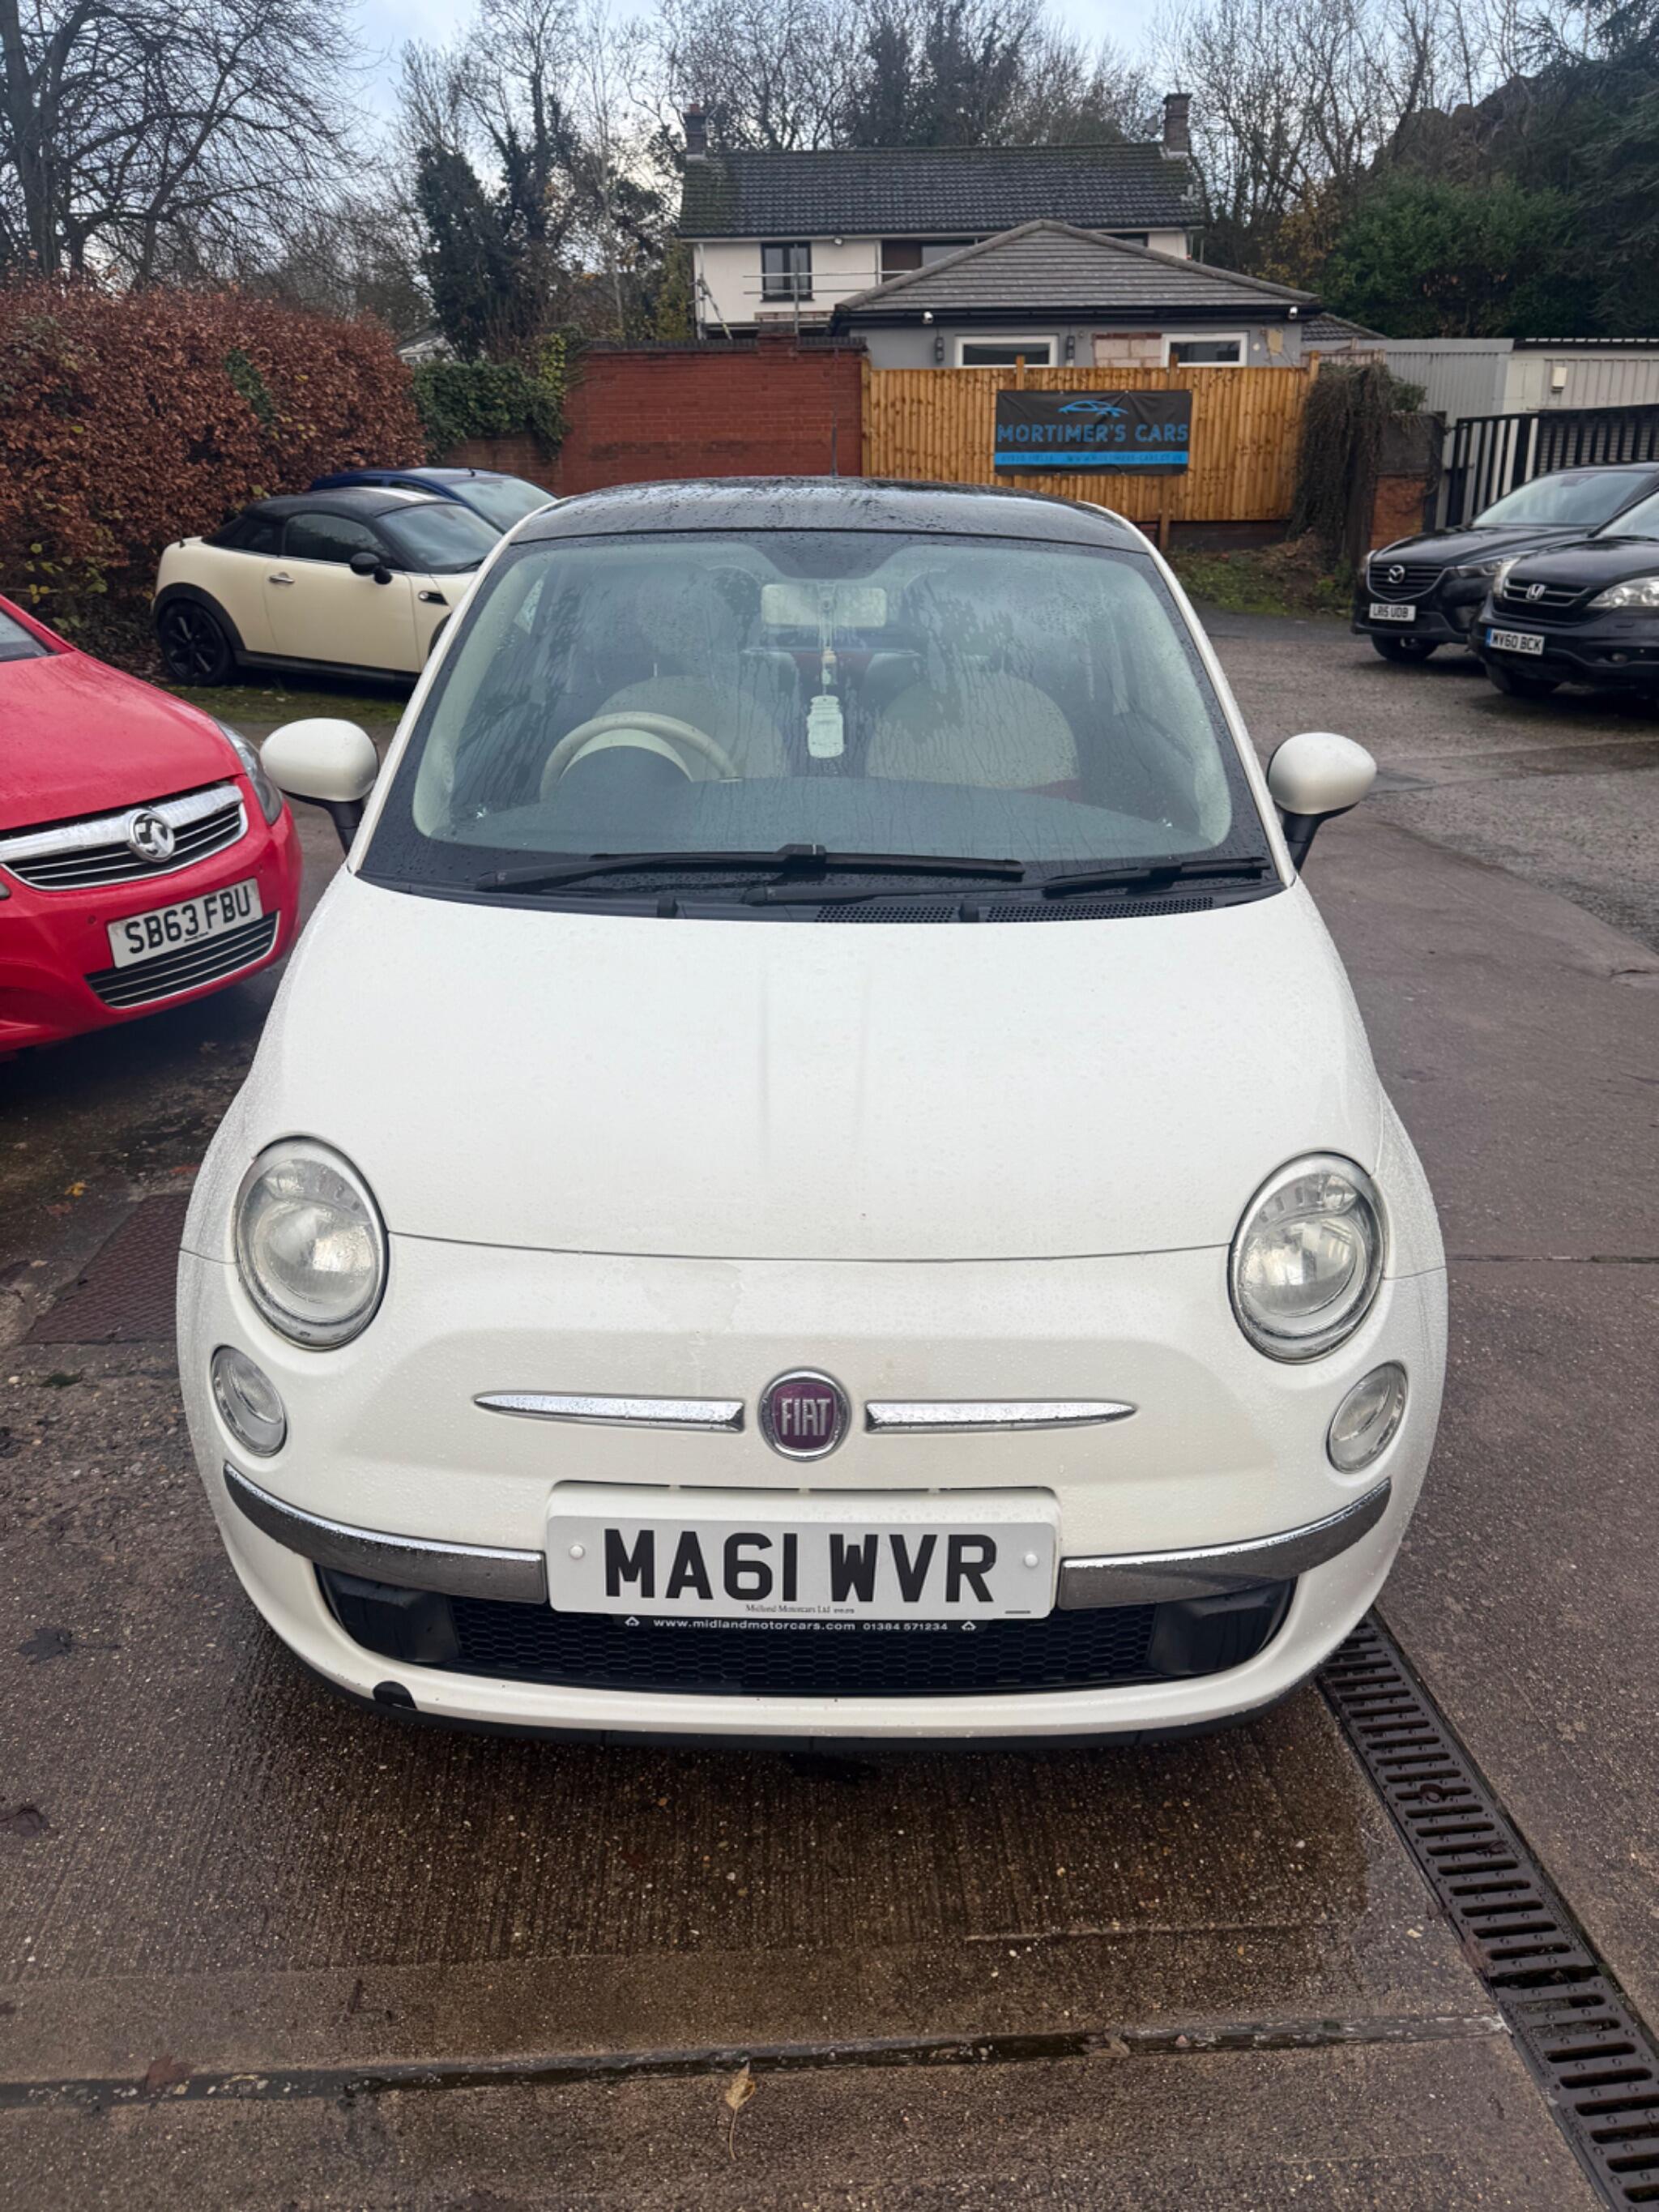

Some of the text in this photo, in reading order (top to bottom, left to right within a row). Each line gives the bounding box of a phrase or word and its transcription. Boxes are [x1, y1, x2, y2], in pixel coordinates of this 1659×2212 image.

[996, 423, 1188, 442] MORTIMER'S CARS
[1520, 635, 1542, 651] BCK
[125, 885, 251, 954] SB63 FBU
[780, 1398, 831, 1436] FIAT
[603, 1528, 997, 1603] MA61 WVR
[653, 1618, 949, 1631] www.midlandmotorcars.com 01384 571234
